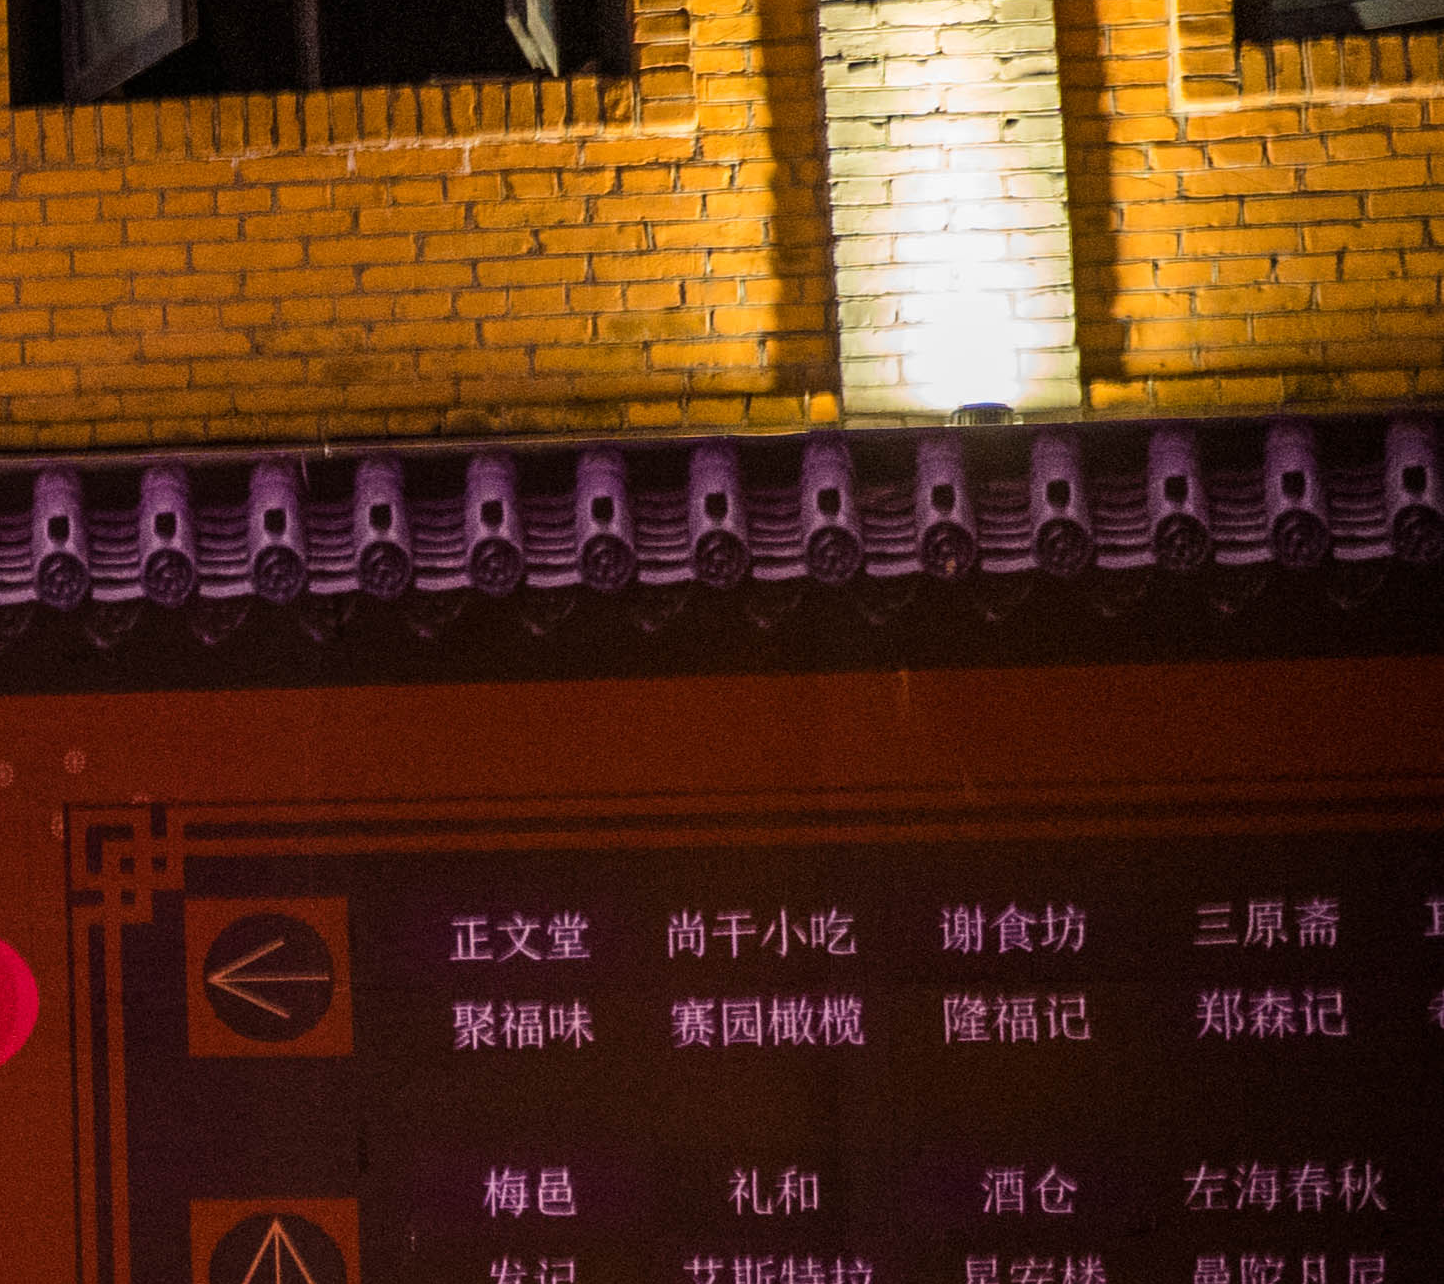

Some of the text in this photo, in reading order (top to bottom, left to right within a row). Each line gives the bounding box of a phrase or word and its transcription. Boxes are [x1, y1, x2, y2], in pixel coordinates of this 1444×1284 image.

[450, 898, 1339, 961] 正文堂 尚干小吃 谢食坊 三原斋
[454, 990, 1347, 1049] 聚福味 赛园橄榄 隆福记 郑森记
[485, 1162, 1385, 1217] 梅邑 礼和 酒仓 左海春秋
